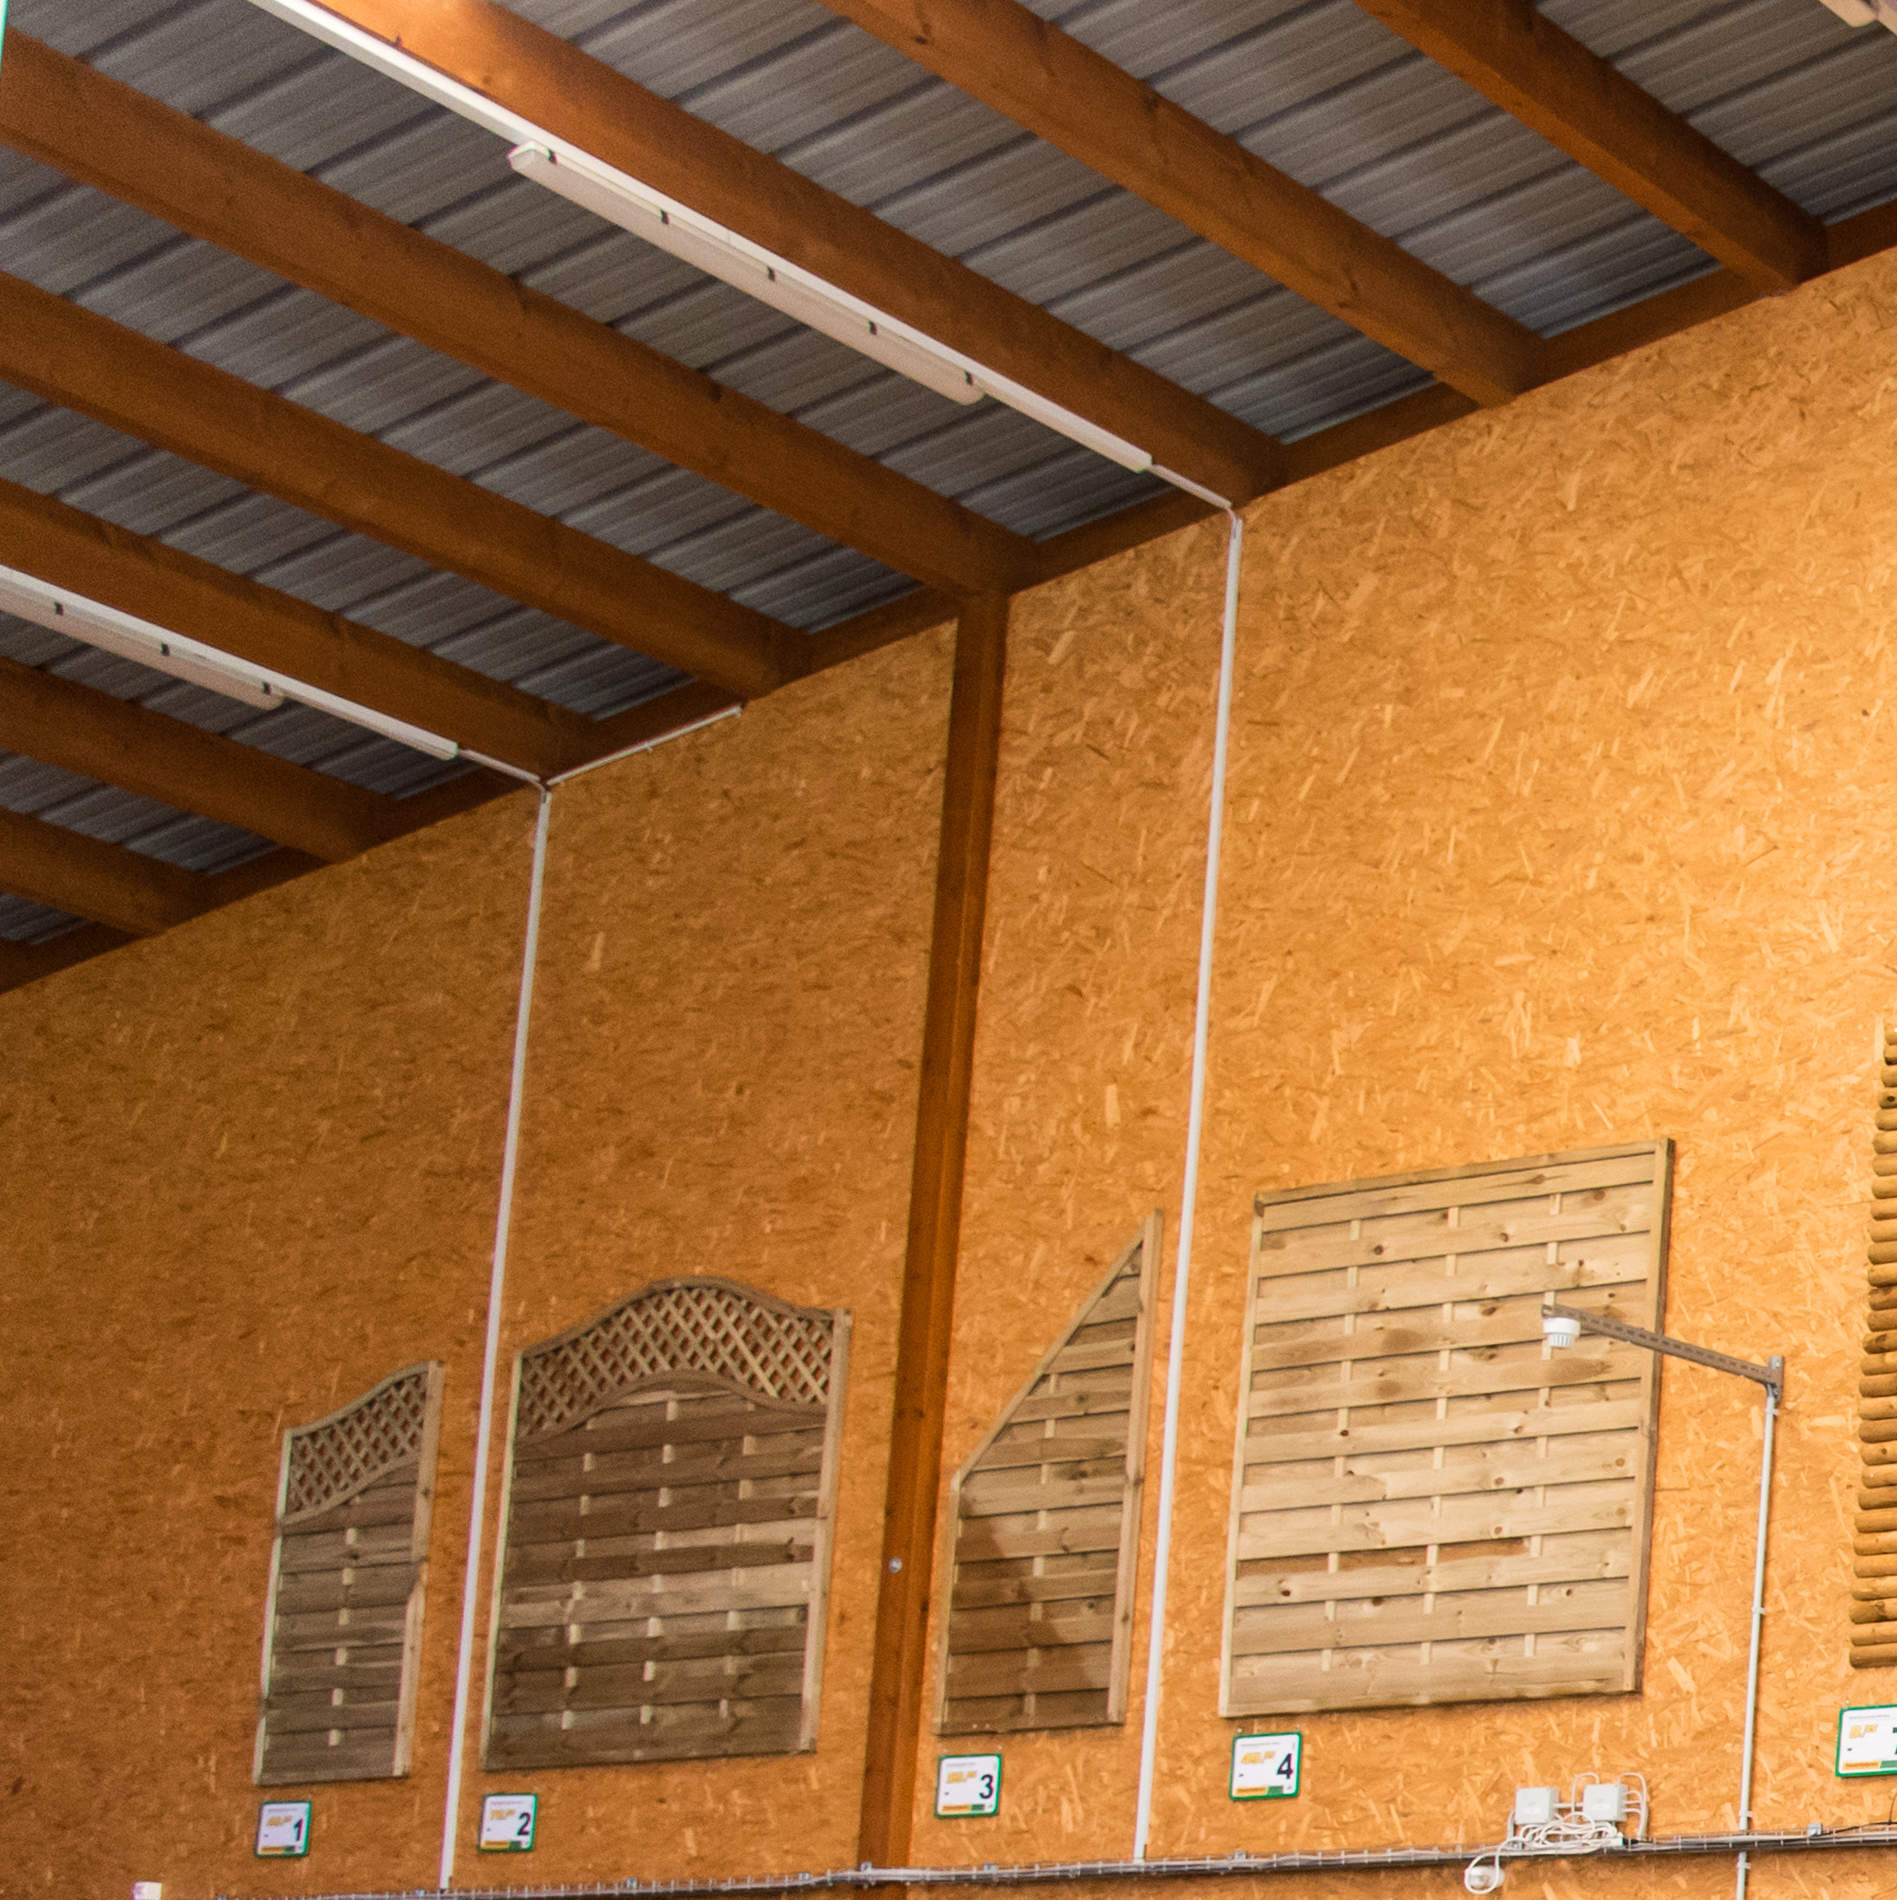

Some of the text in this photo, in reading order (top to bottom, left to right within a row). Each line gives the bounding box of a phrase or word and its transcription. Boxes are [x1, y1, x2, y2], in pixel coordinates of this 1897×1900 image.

[1277, 1753, 1293, 1779] 4
[979, 1773, 994, 1800] 3
[293, 1818, 304, 1842] 1
[517, 1812, 532, 1836] 2
